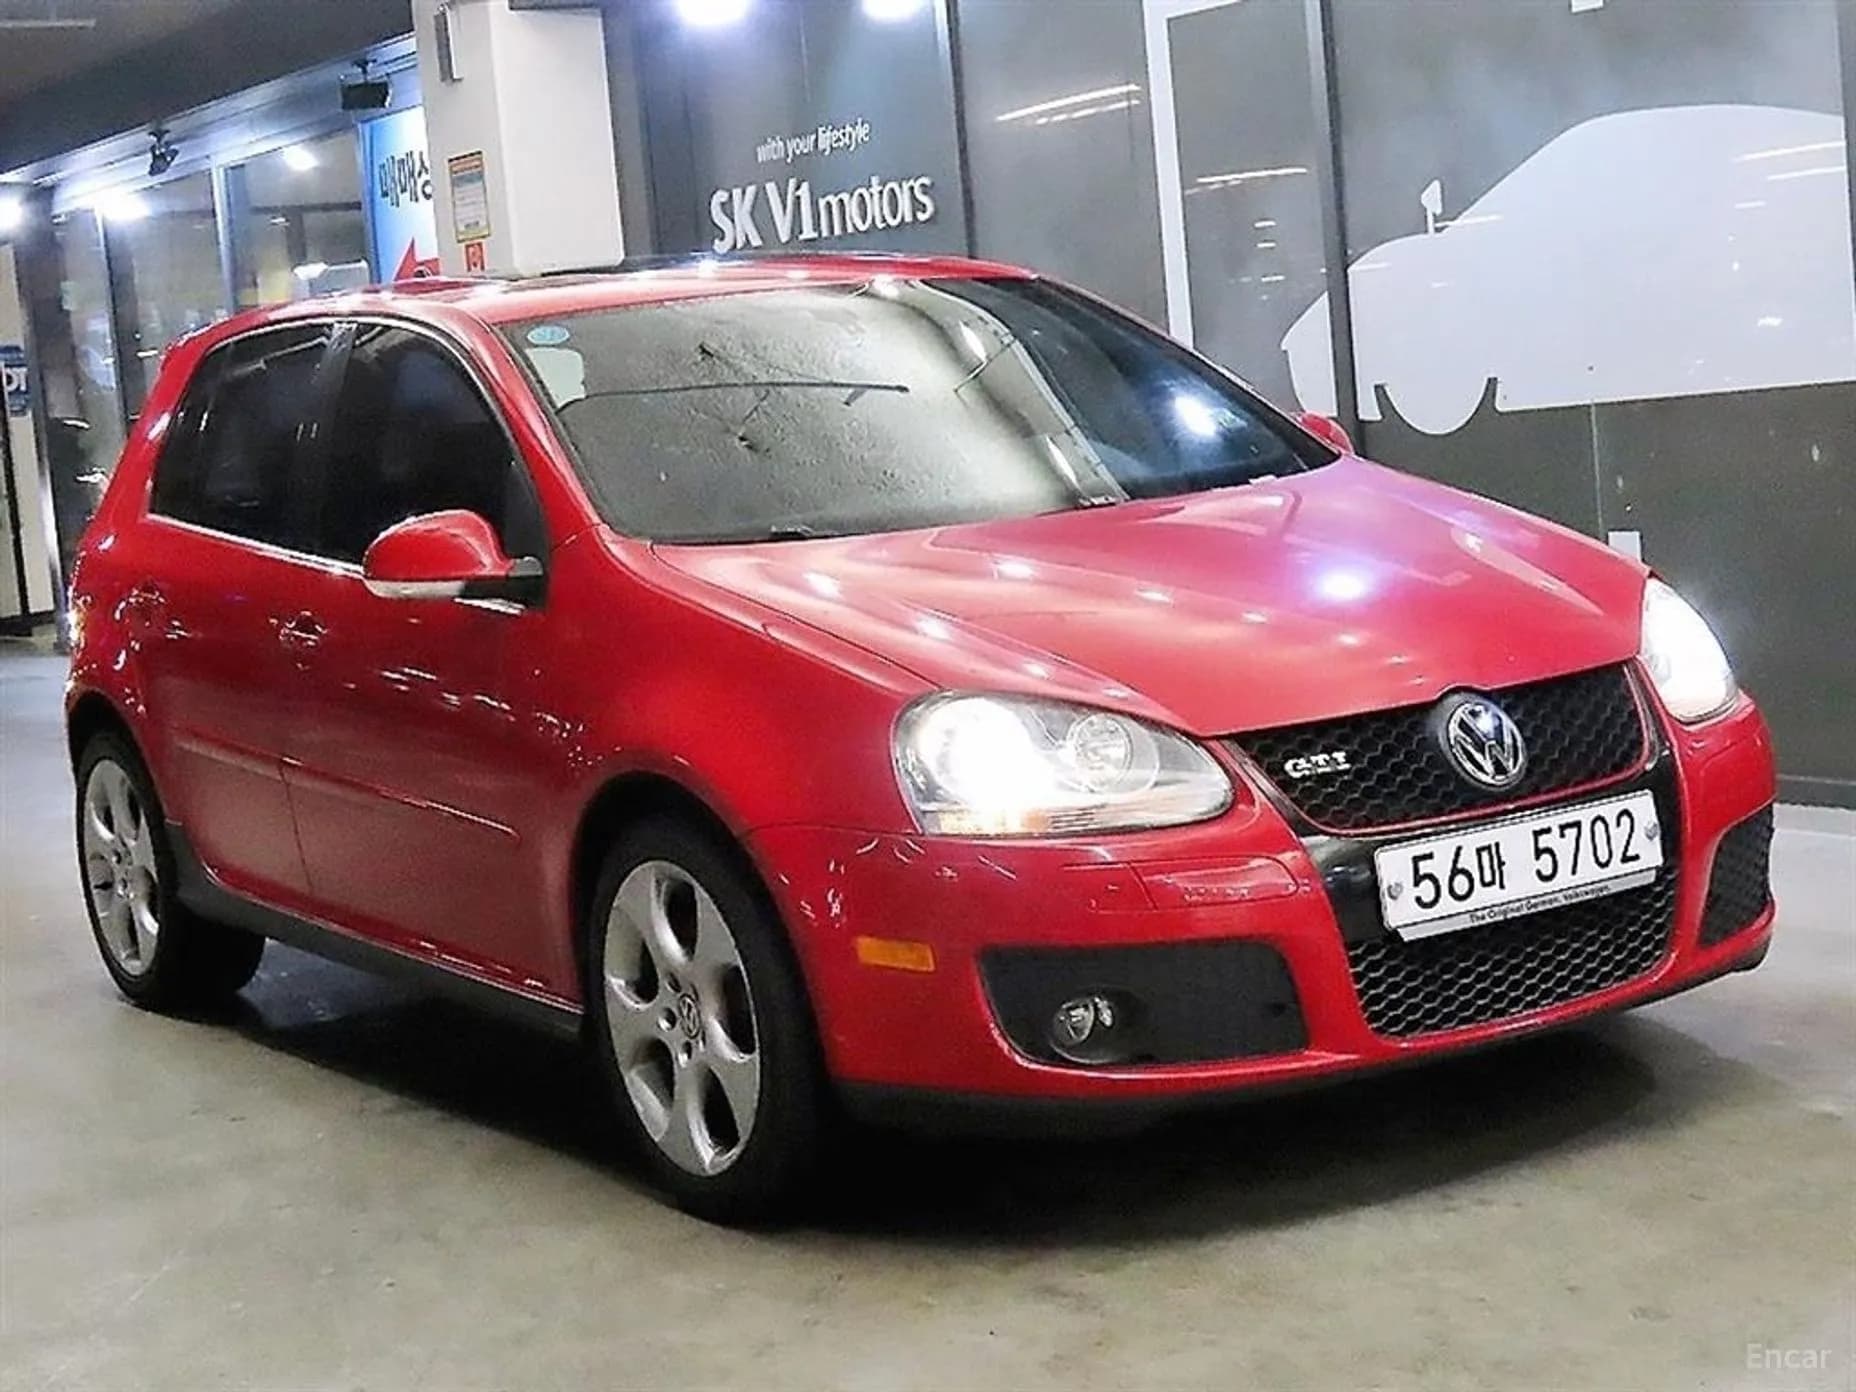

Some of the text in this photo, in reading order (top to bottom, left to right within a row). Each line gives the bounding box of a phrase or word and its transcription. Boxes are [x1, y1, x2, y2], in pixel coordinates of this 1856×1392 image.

[757, 117, 870, 163] with your lifestyle
[710, 184, 763, 255] SK
[1284, 751, 1351, 779] GTI
[1410, 808, 1641, 909] 56마 5702
